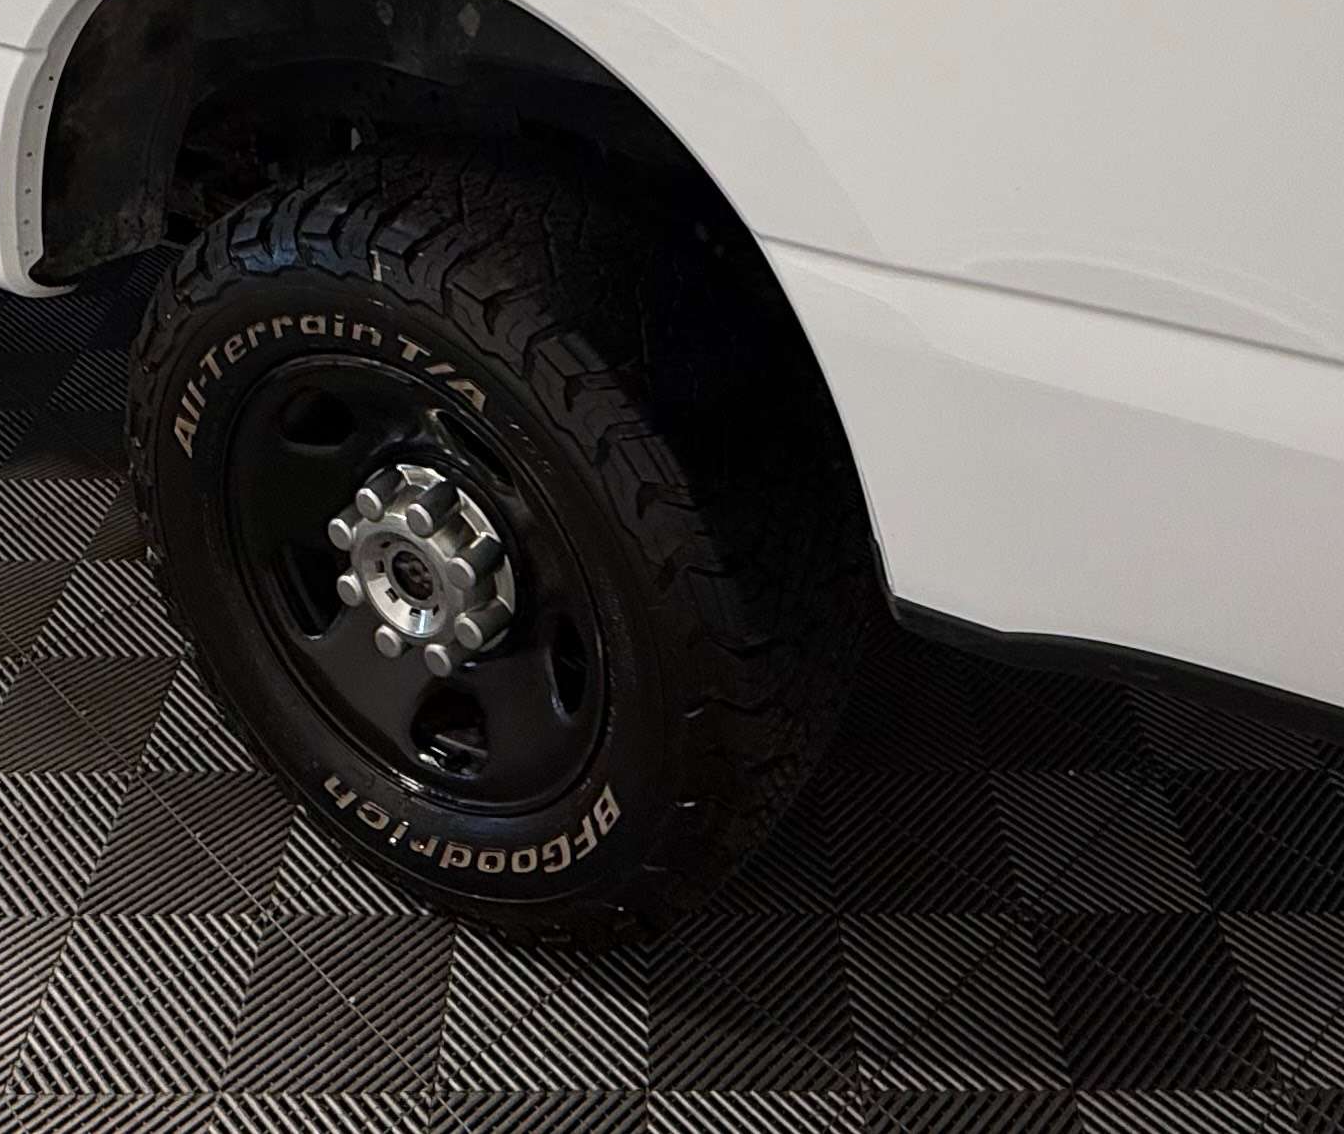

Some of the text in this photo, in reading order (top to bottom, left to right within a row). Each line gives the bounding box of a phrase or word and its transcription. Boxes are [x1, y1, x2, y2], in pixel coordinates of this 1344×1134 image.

[172, 312, 384, 459] All-Terrain
[396, 332, 489, 415] T/A
[321, 773, 623, 876] BFGoodrich
